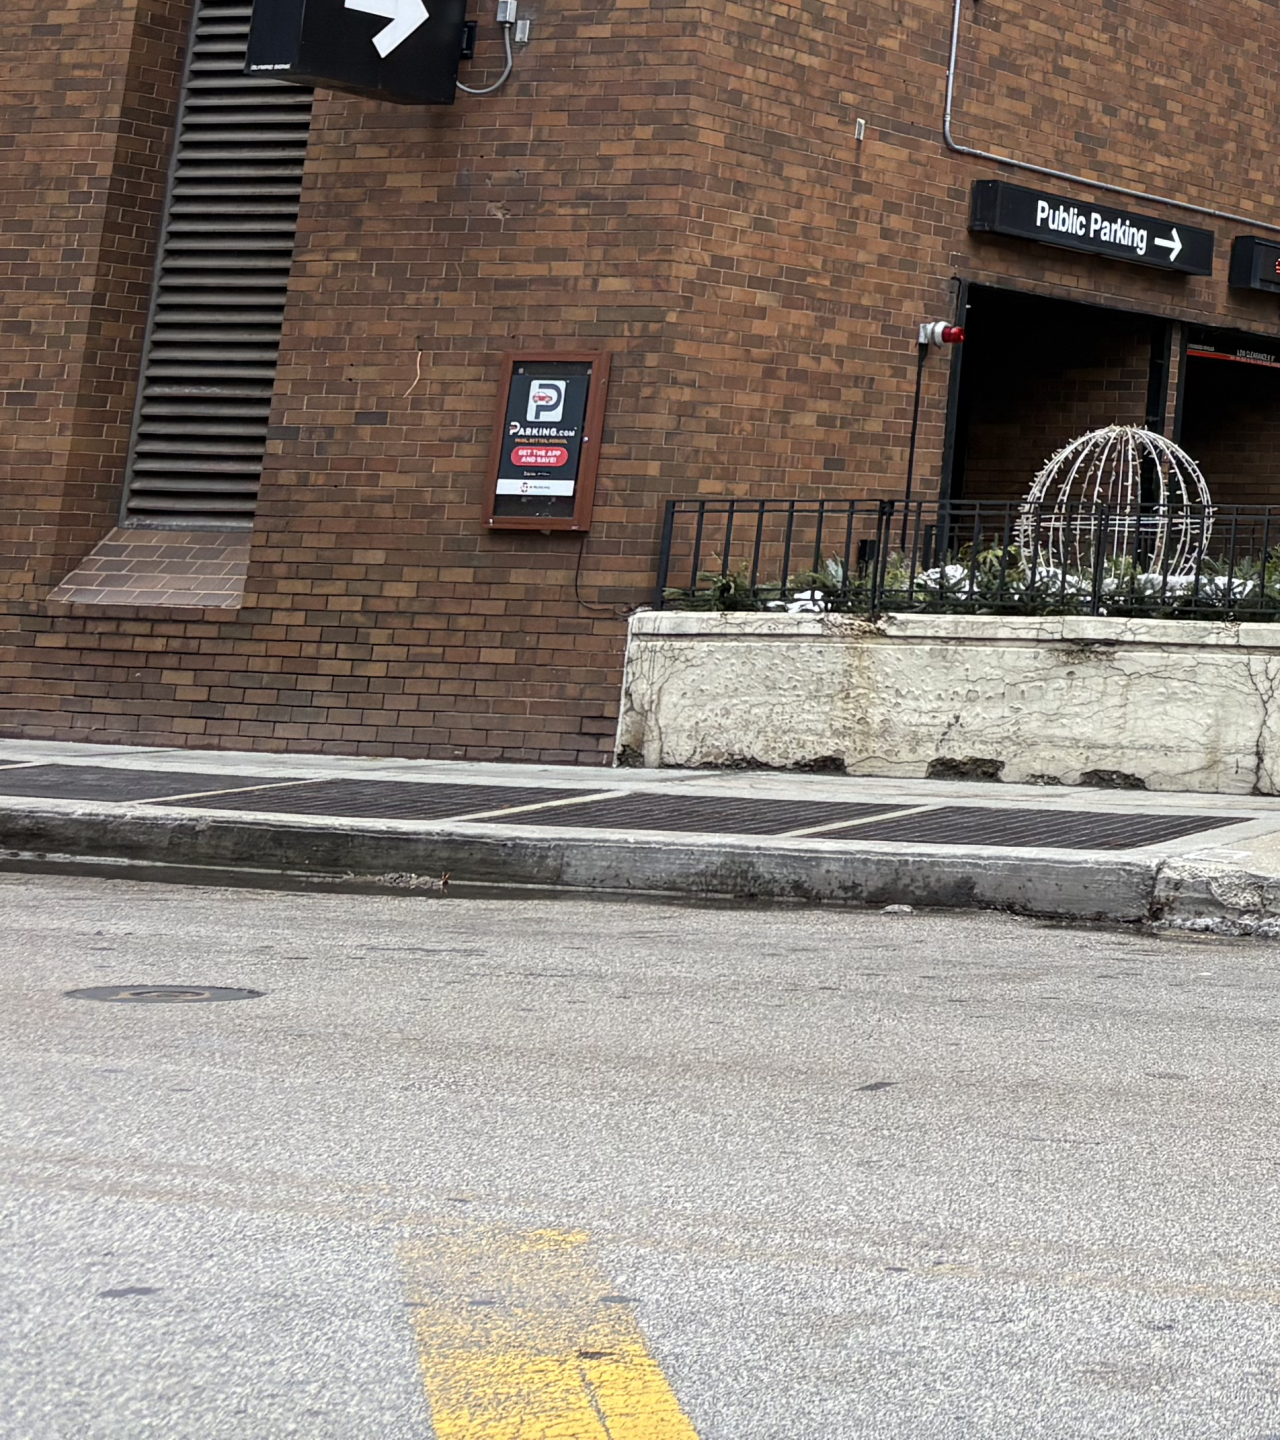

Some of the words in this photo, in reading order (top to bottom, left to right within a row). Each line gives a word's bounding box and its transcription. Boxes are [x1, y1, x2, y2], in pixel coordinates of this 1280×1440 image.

[1036, 200, 1086, 237] Public
[1089, 212, 1148, 256] Parking
[518, 449, 531, 457] GET
[533, 449, 546, 457] THE
[547, 449, 561, 458] APP
